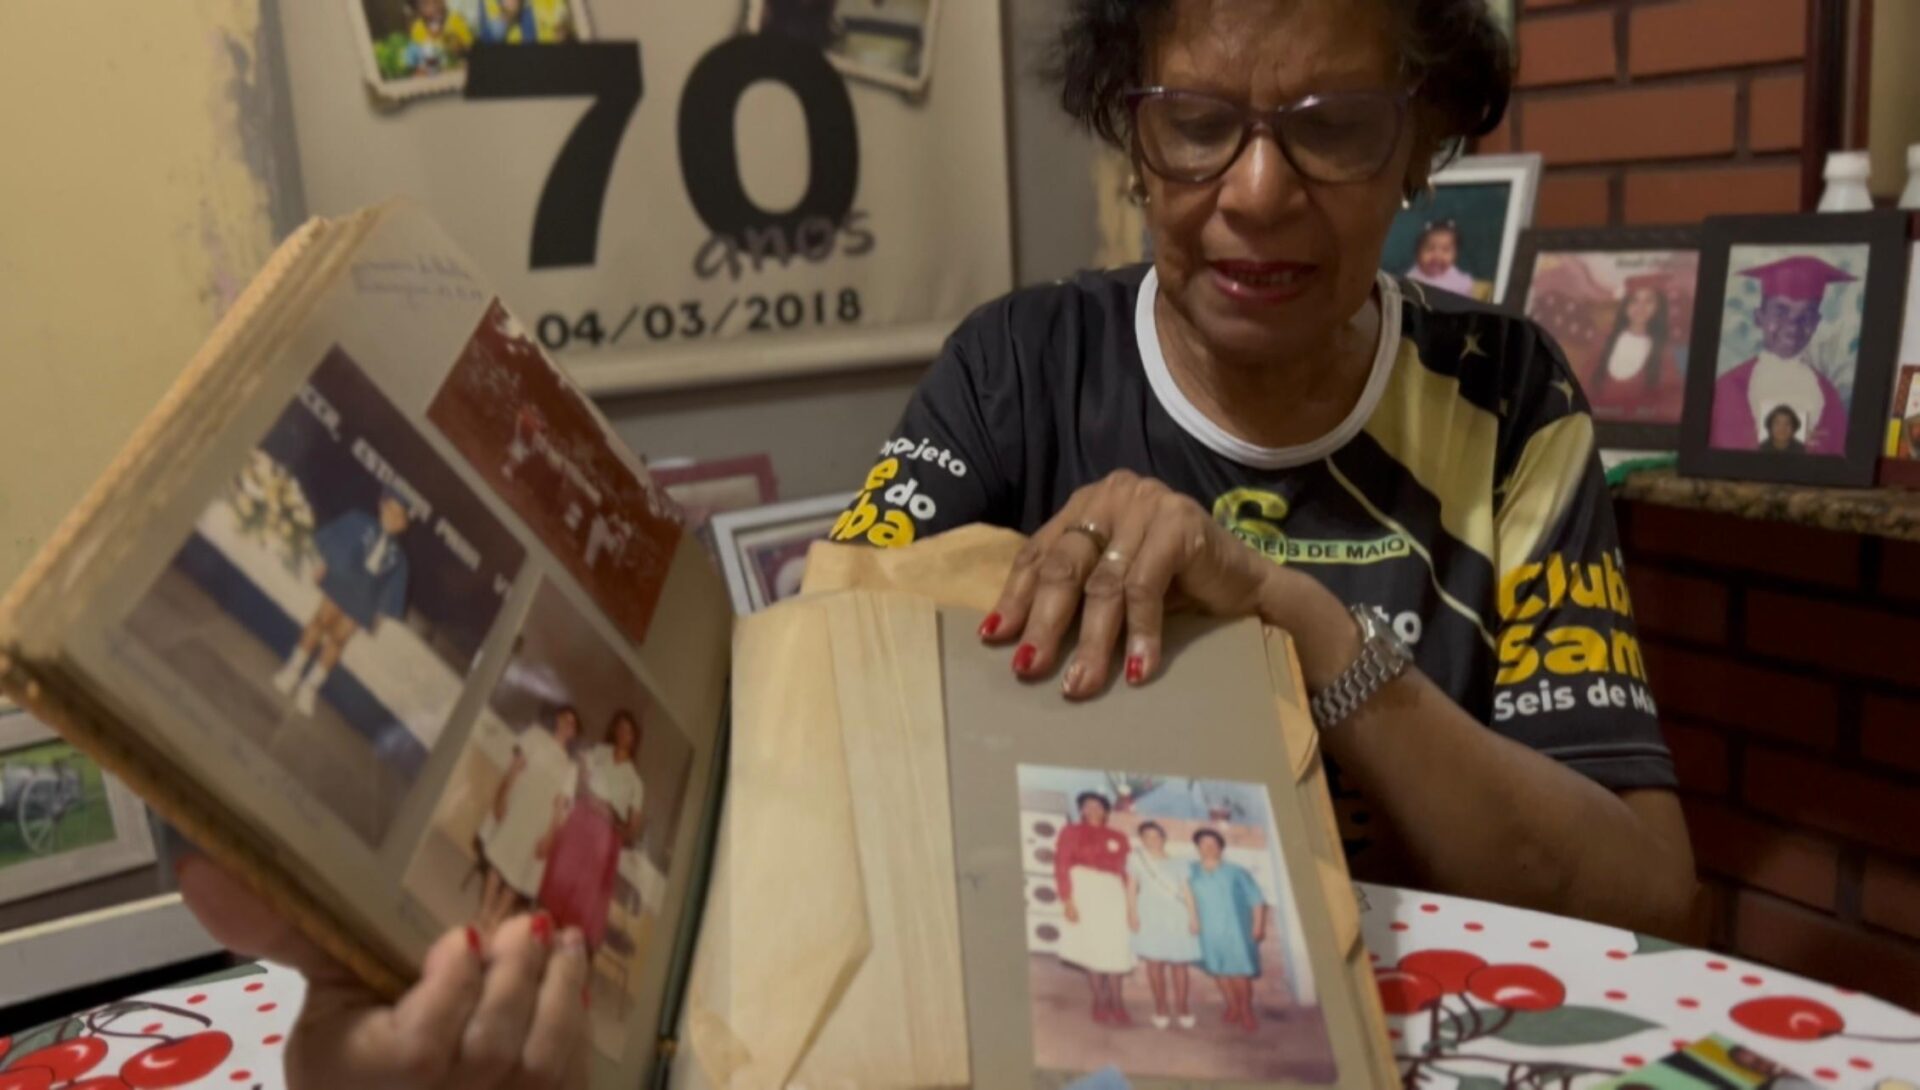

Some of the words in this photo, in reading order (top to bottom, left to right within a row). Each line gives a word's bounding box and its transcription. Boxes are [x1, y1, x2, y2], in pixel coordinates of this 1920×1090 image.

[464, 33, 860, 271] 70
[694, 210, 875, 281] anos
[536, 287, 861, 351] 04/03/2018
[884, 477, 936, 521] do
[1307, 543, 1339, 558] DE
[1346, 537, 1405, 559] MAIO
[1498, 552, 1634, 621] Club
[1494, 679, 1575, 721] Seis
[1587, 677, 1626, 708] de
